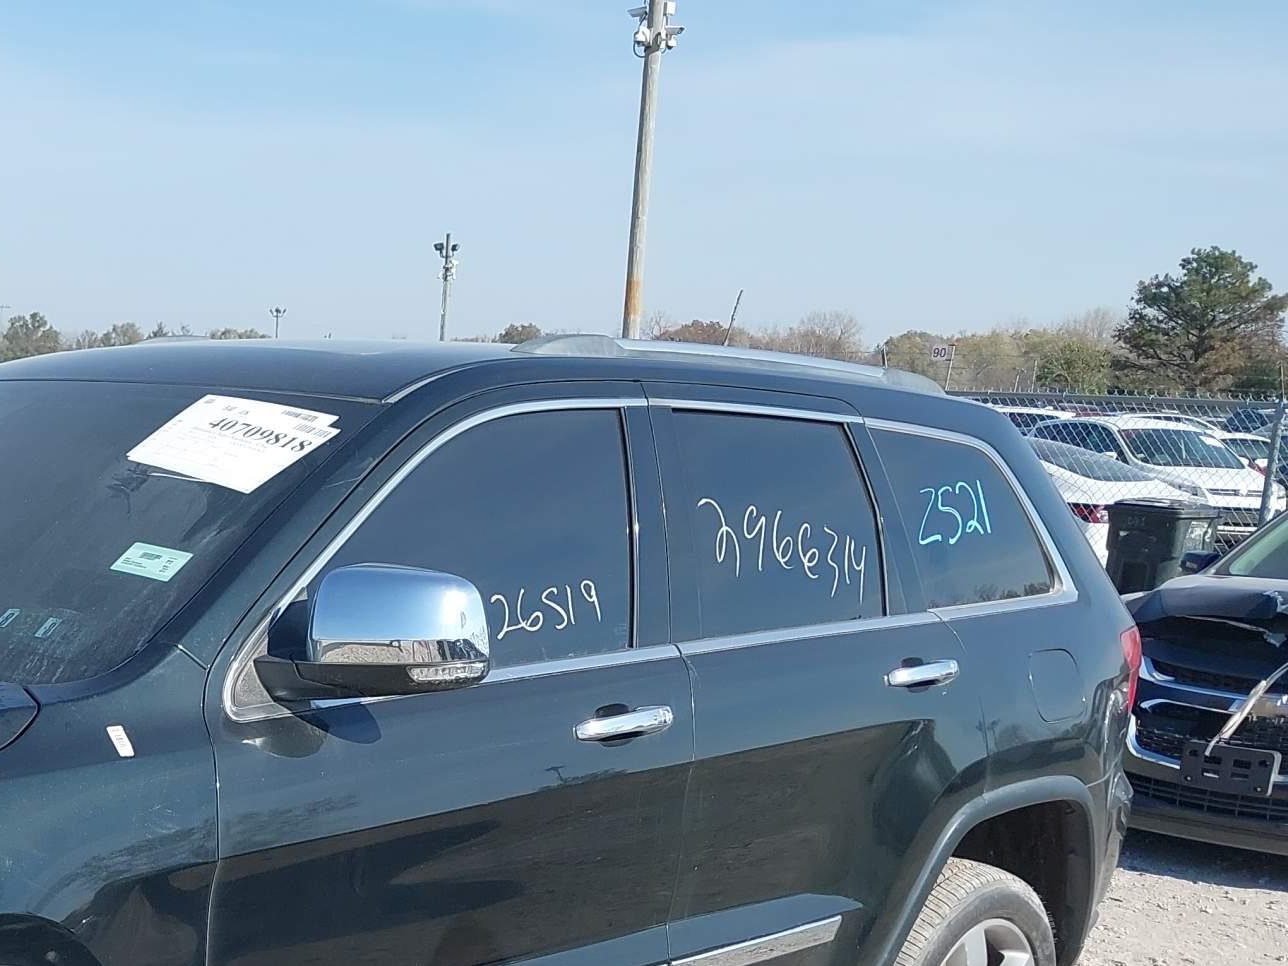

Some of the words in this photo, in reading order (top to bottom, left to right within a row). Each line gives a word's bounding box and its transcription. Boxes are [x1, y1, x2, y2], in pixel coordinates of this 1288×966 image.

[932, 347, 947, 358] 90
[209, 417, 312, 452] 40709818
[697, 498, 866, 605] 2966314
[490, 580, 601, 640] 26519
